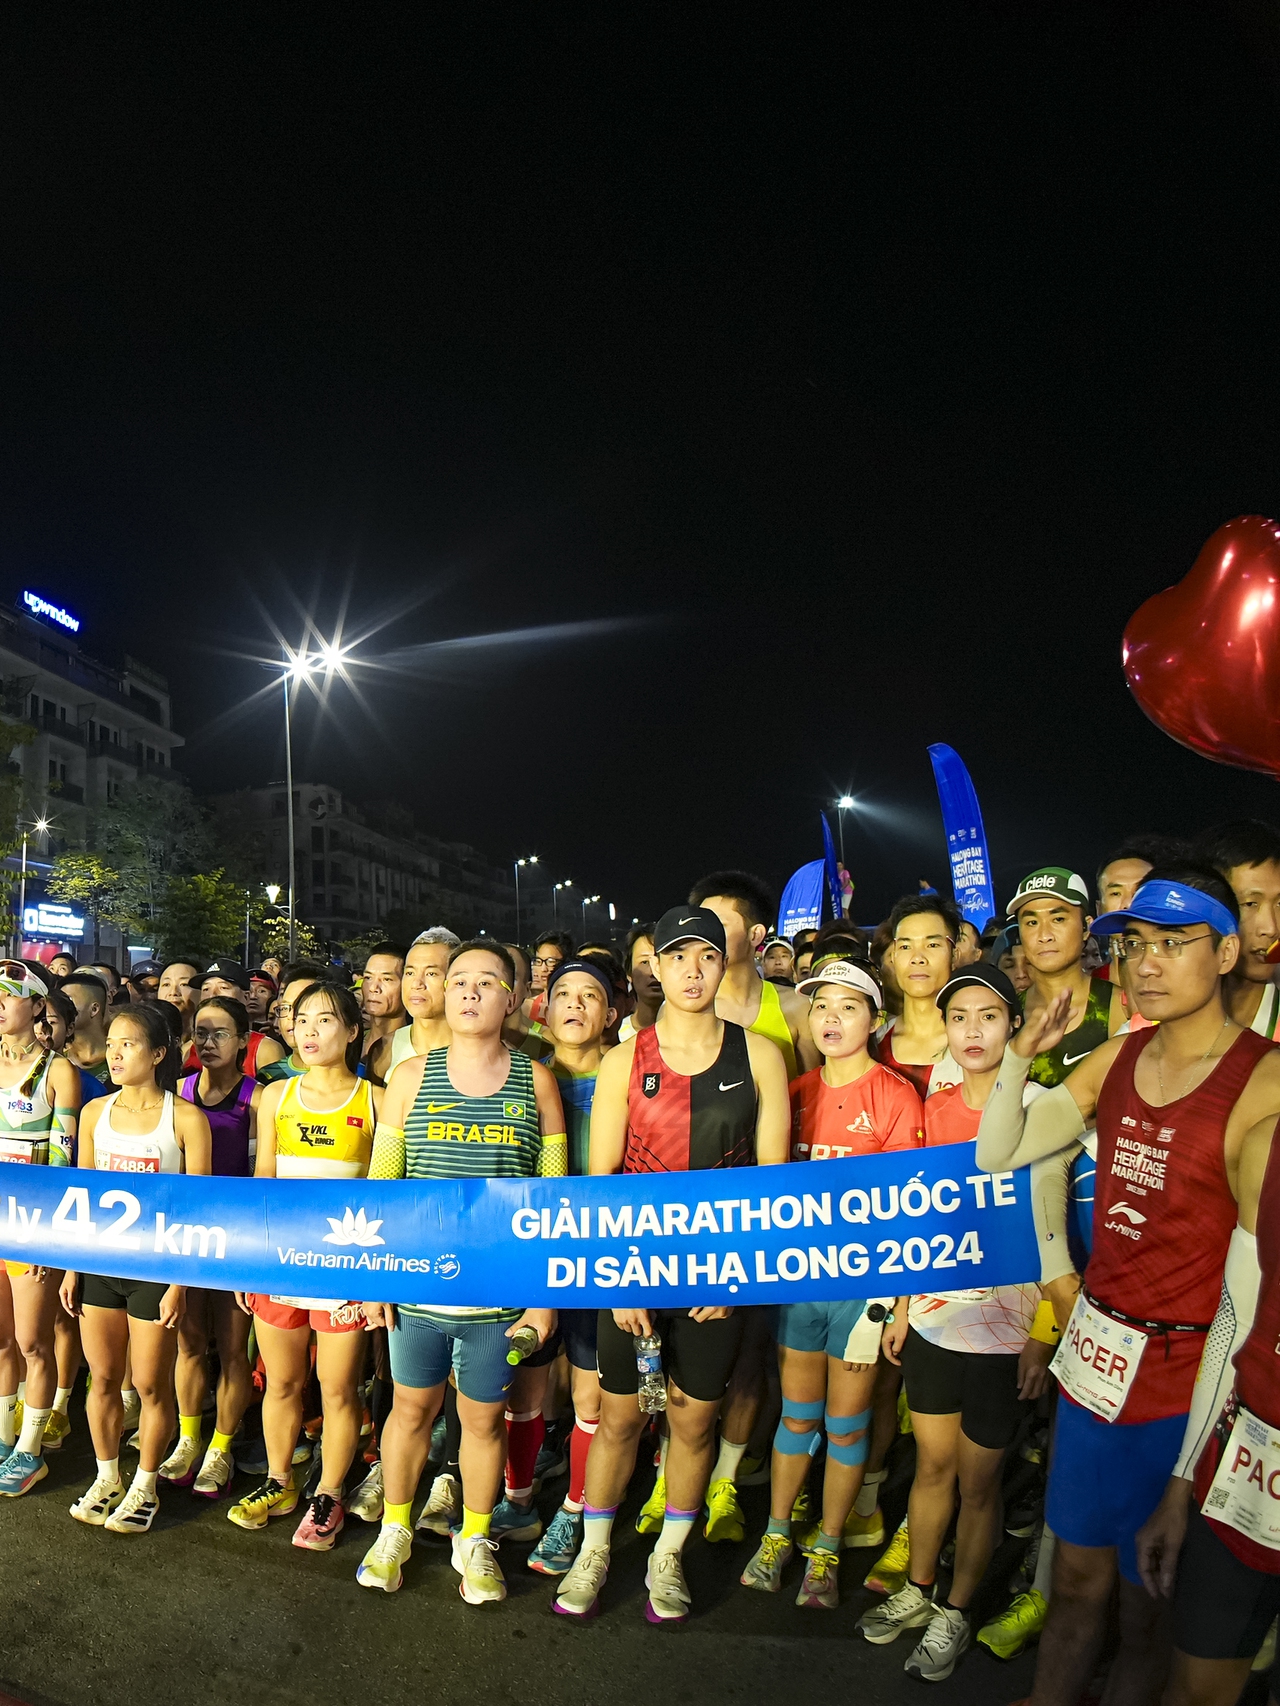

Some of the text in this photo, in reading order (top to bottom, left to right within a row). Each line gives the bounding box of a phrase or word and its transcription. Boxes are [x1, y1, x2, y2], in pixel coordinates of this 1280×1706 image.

[952, 860, 985, 878] HERITAGE
[954, 873, 986, 890] MARATHON
[310, 1125, 328, 1135] VKL
[427, 1121, 522, 1147] BRASIL
[1116, 1136, 1170, 1161] HALONG BAY
[112, 1157, 155, 1174] 74884
[1111, 1163, 1164, 1191] MARATHON
[1114, 1149, 1167, 1179] HERITAGE
[511, 1170, 961, 1241] GIẢI MARATHON QUỐC
[8, 1194, 43, 1244] ly
[51, 1185, 143, 1252] 42
[154, 1211, 228, 1260] km
[546, 1230, 984, 1294] DI SẢN HẠ LONG 2024
[1069, 1318, 1129, 1384] PACER
[1230, 1444, 1280, 1501] PAC
